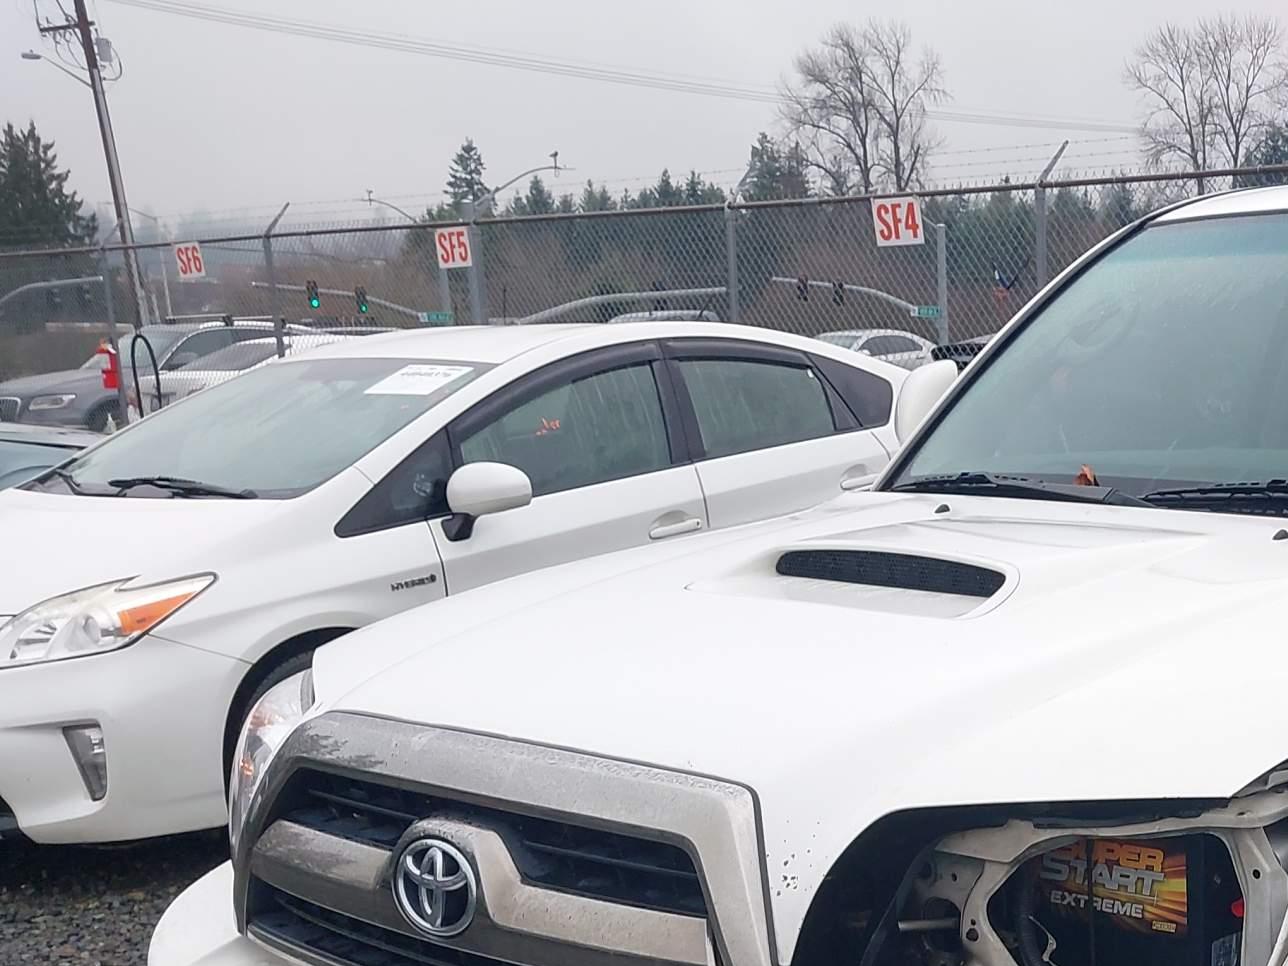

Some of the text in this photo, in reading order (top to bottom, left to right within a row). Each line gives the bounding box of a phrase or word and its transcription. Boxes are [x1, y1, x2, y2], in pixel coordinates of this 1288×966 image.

[875, 201, 920, 240] SF4
[176, 245, 203, 275] SF6
[437, 228, 470, 264] SF5
[1040, 852, 1165, 896] START
